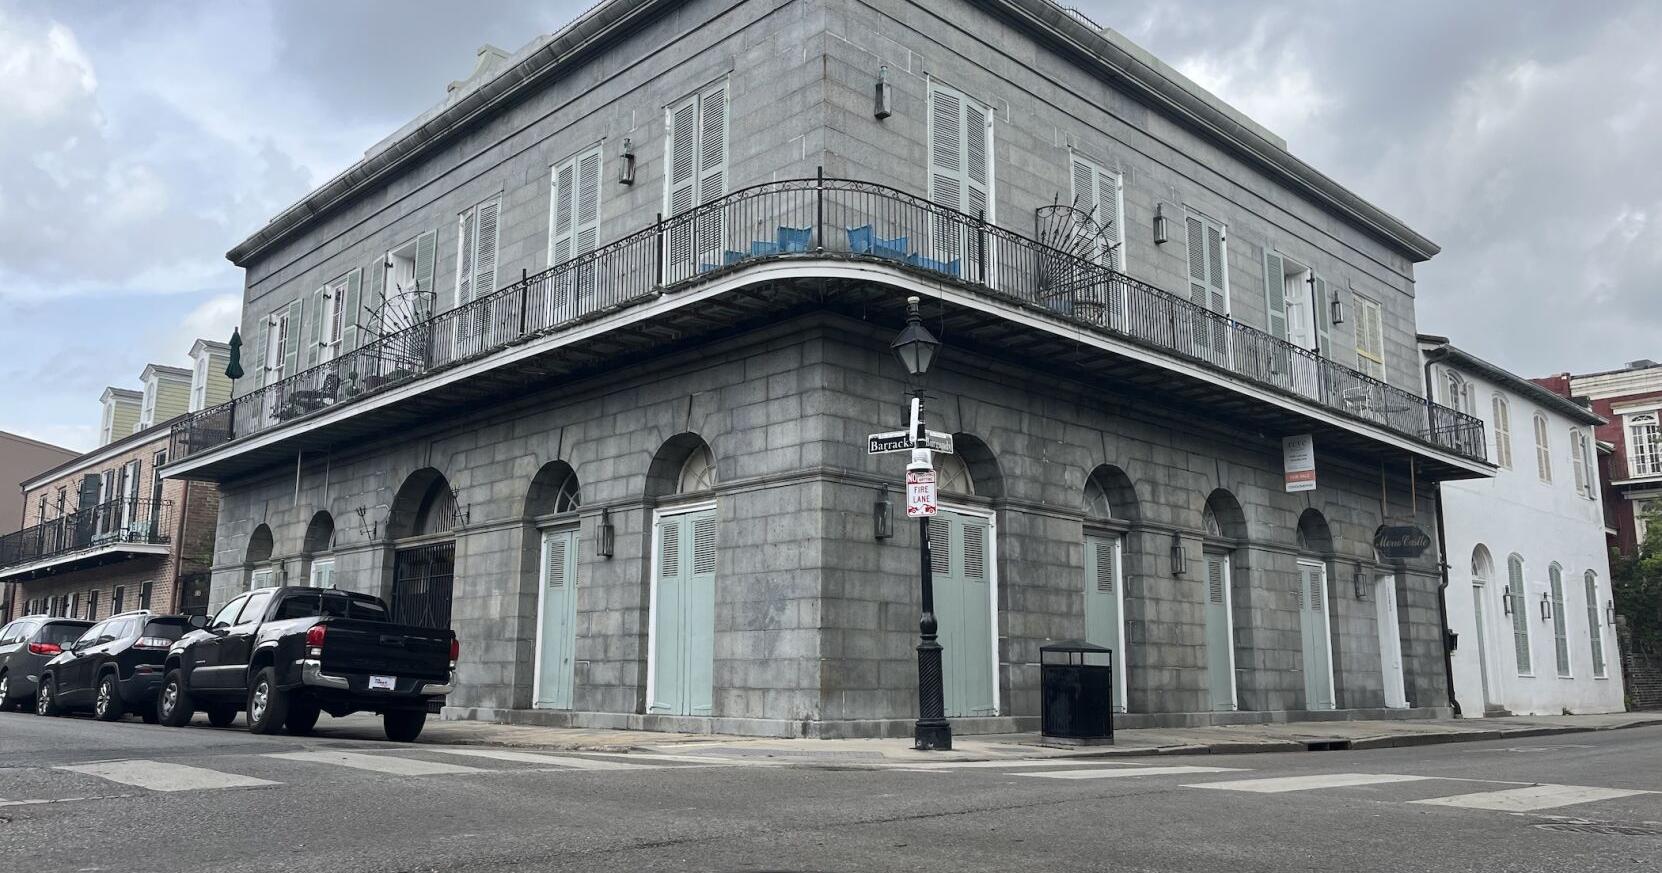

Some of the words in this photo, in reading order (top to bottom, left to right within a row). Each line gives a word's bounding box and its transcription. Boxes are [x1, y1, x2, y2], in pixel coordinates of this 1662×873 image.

[871, 438, 914, 451] Barracks
[908, 473, 917, 482] NO
[914, 486, 929, 494] FIRE
[913, 495, 930, 503] LANE
